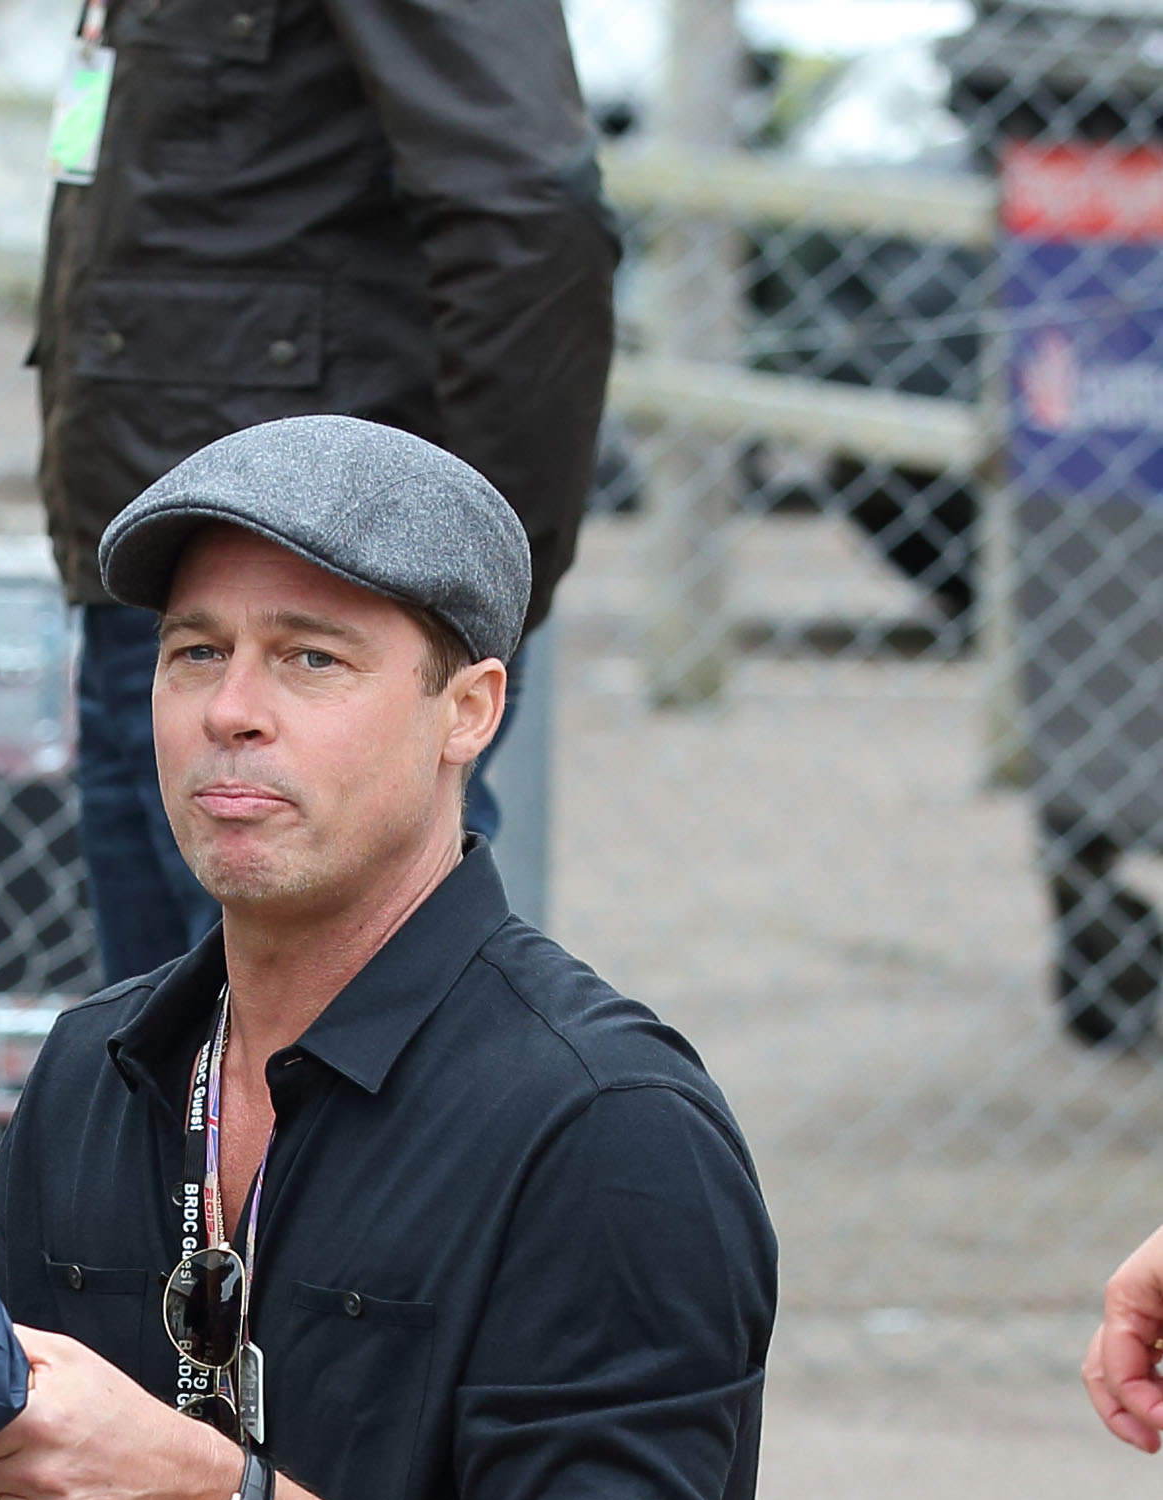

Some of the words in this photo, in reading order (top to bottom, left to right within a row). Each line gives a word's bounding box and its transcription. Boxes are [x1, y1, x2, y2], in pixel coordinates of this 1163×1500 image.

[190, 1086, 207, 1131] Guest
[182, 1183, 199, 1233] BRDC
[180, 1236, 198, 1285] Guest
